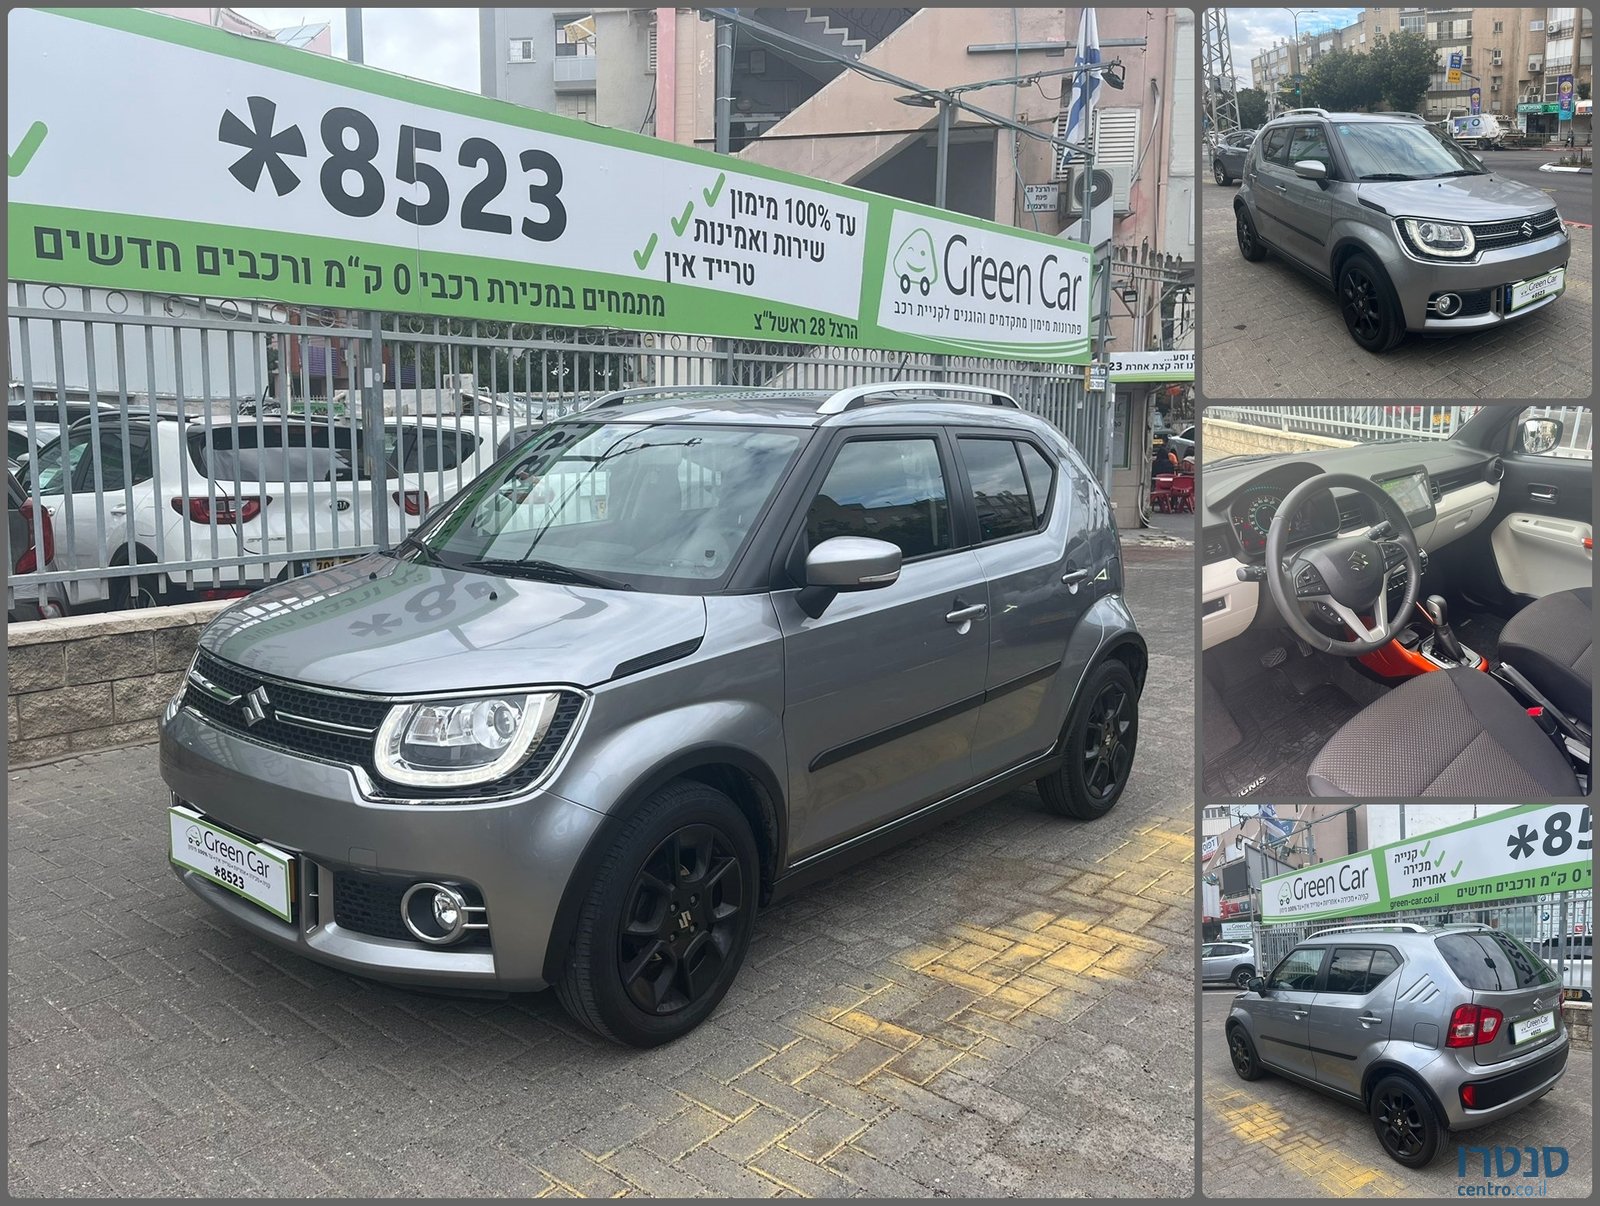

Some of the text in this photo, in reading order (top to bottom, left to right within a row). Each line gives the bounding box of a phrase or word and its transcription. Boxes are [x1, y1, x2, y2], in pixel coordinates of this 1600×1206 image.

[730, 188, 857, 237] עד 100% מימון
[34, 226, 182, 273] חדשים
[693, 218, 825, 263] שירות ואמינות
[196, 245, 312, 286] ורכבים
[393, 262, 411, 296] 0
[664, 251, 755, 286] טרייד אין
[943, 233, 1082, 312] Green Car
[420, 271, 479, 301] רכבי
[487, 278, 576, 309] במכירת
[583, 287, 666, 318] מתמחים
[894, 300, 1082, 336] פתרונות מימון מתקדמים והוגנים לקניית רכב
[809, 316, 826, 337] 28
[829, 317, 858, 340] הרצל
[1125, 362, 1149, 371] אחרת
[1152, 362, 1171, 371] קצת
[204, 830, 245, 866] Green
[247, 851, 270, 878] Car
[1394, 848, 1418, 864] קנייה
[1403, 860, 1431, 876] מכירה
[1293, 864, 1369, 901] Green Car
[1411, 872, 1446, 889] אחריות
[1457, 883, 1493, 899] חדשים
[1496, 877, 1536, 893] ורכבים
[1389, 893, 1440, 910] green-car.co.il
